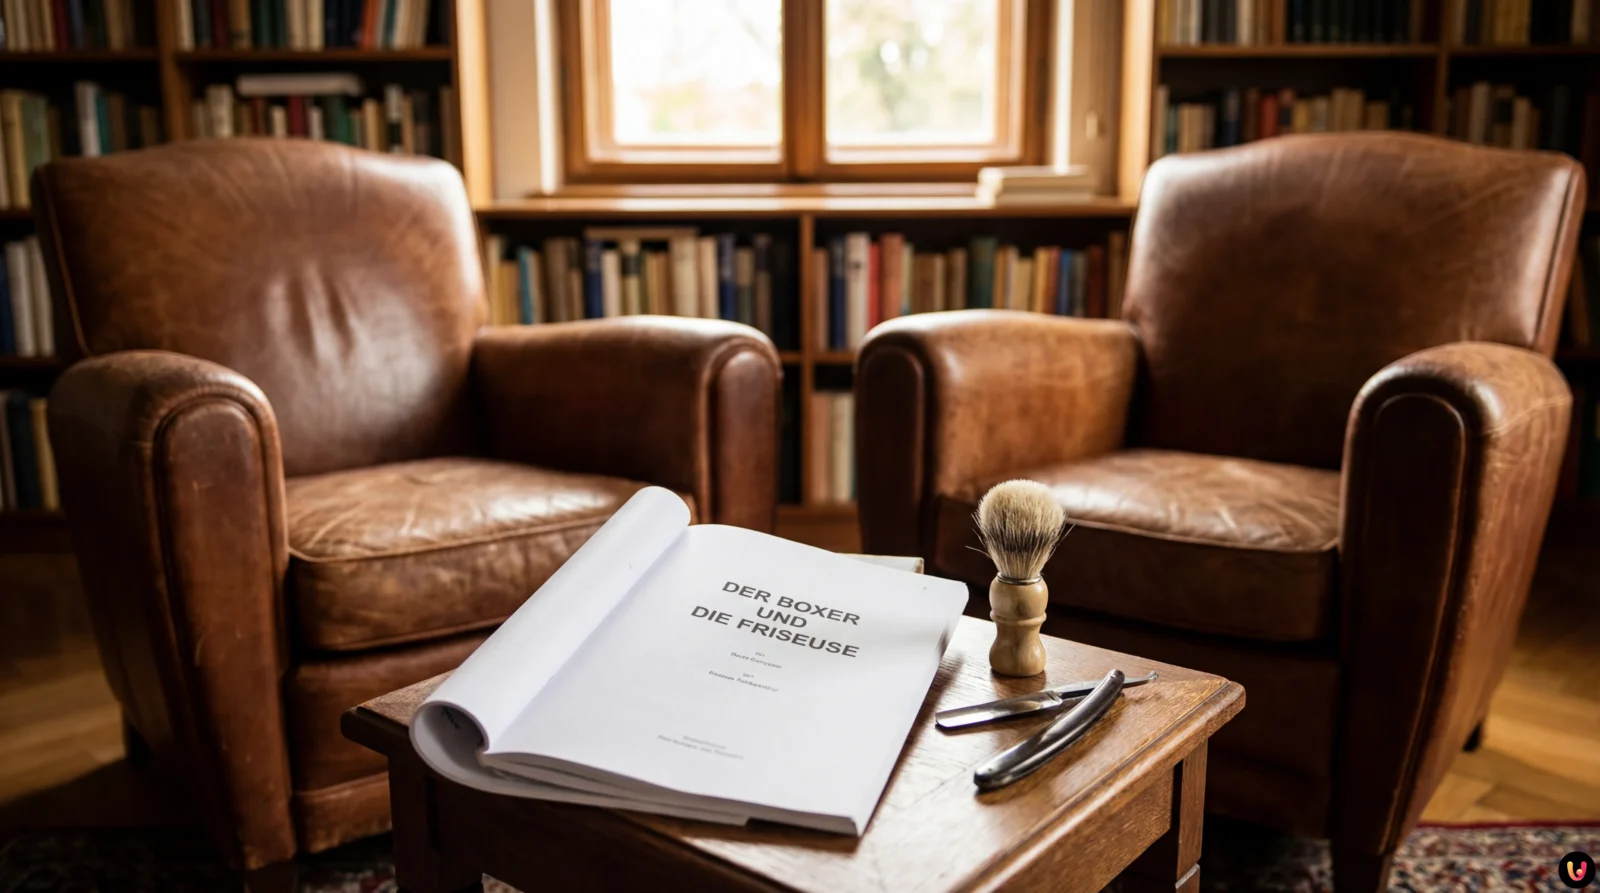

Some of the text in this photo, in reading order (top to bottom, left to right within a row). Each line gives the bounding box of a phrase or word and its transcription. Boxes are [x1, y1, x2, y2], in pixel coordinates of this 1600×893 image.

[722, 581, 861, 626] DER BOXER
[756, 606, 808, 628] UND
[690, 605, 860, 658] DIE FRISEUSE
